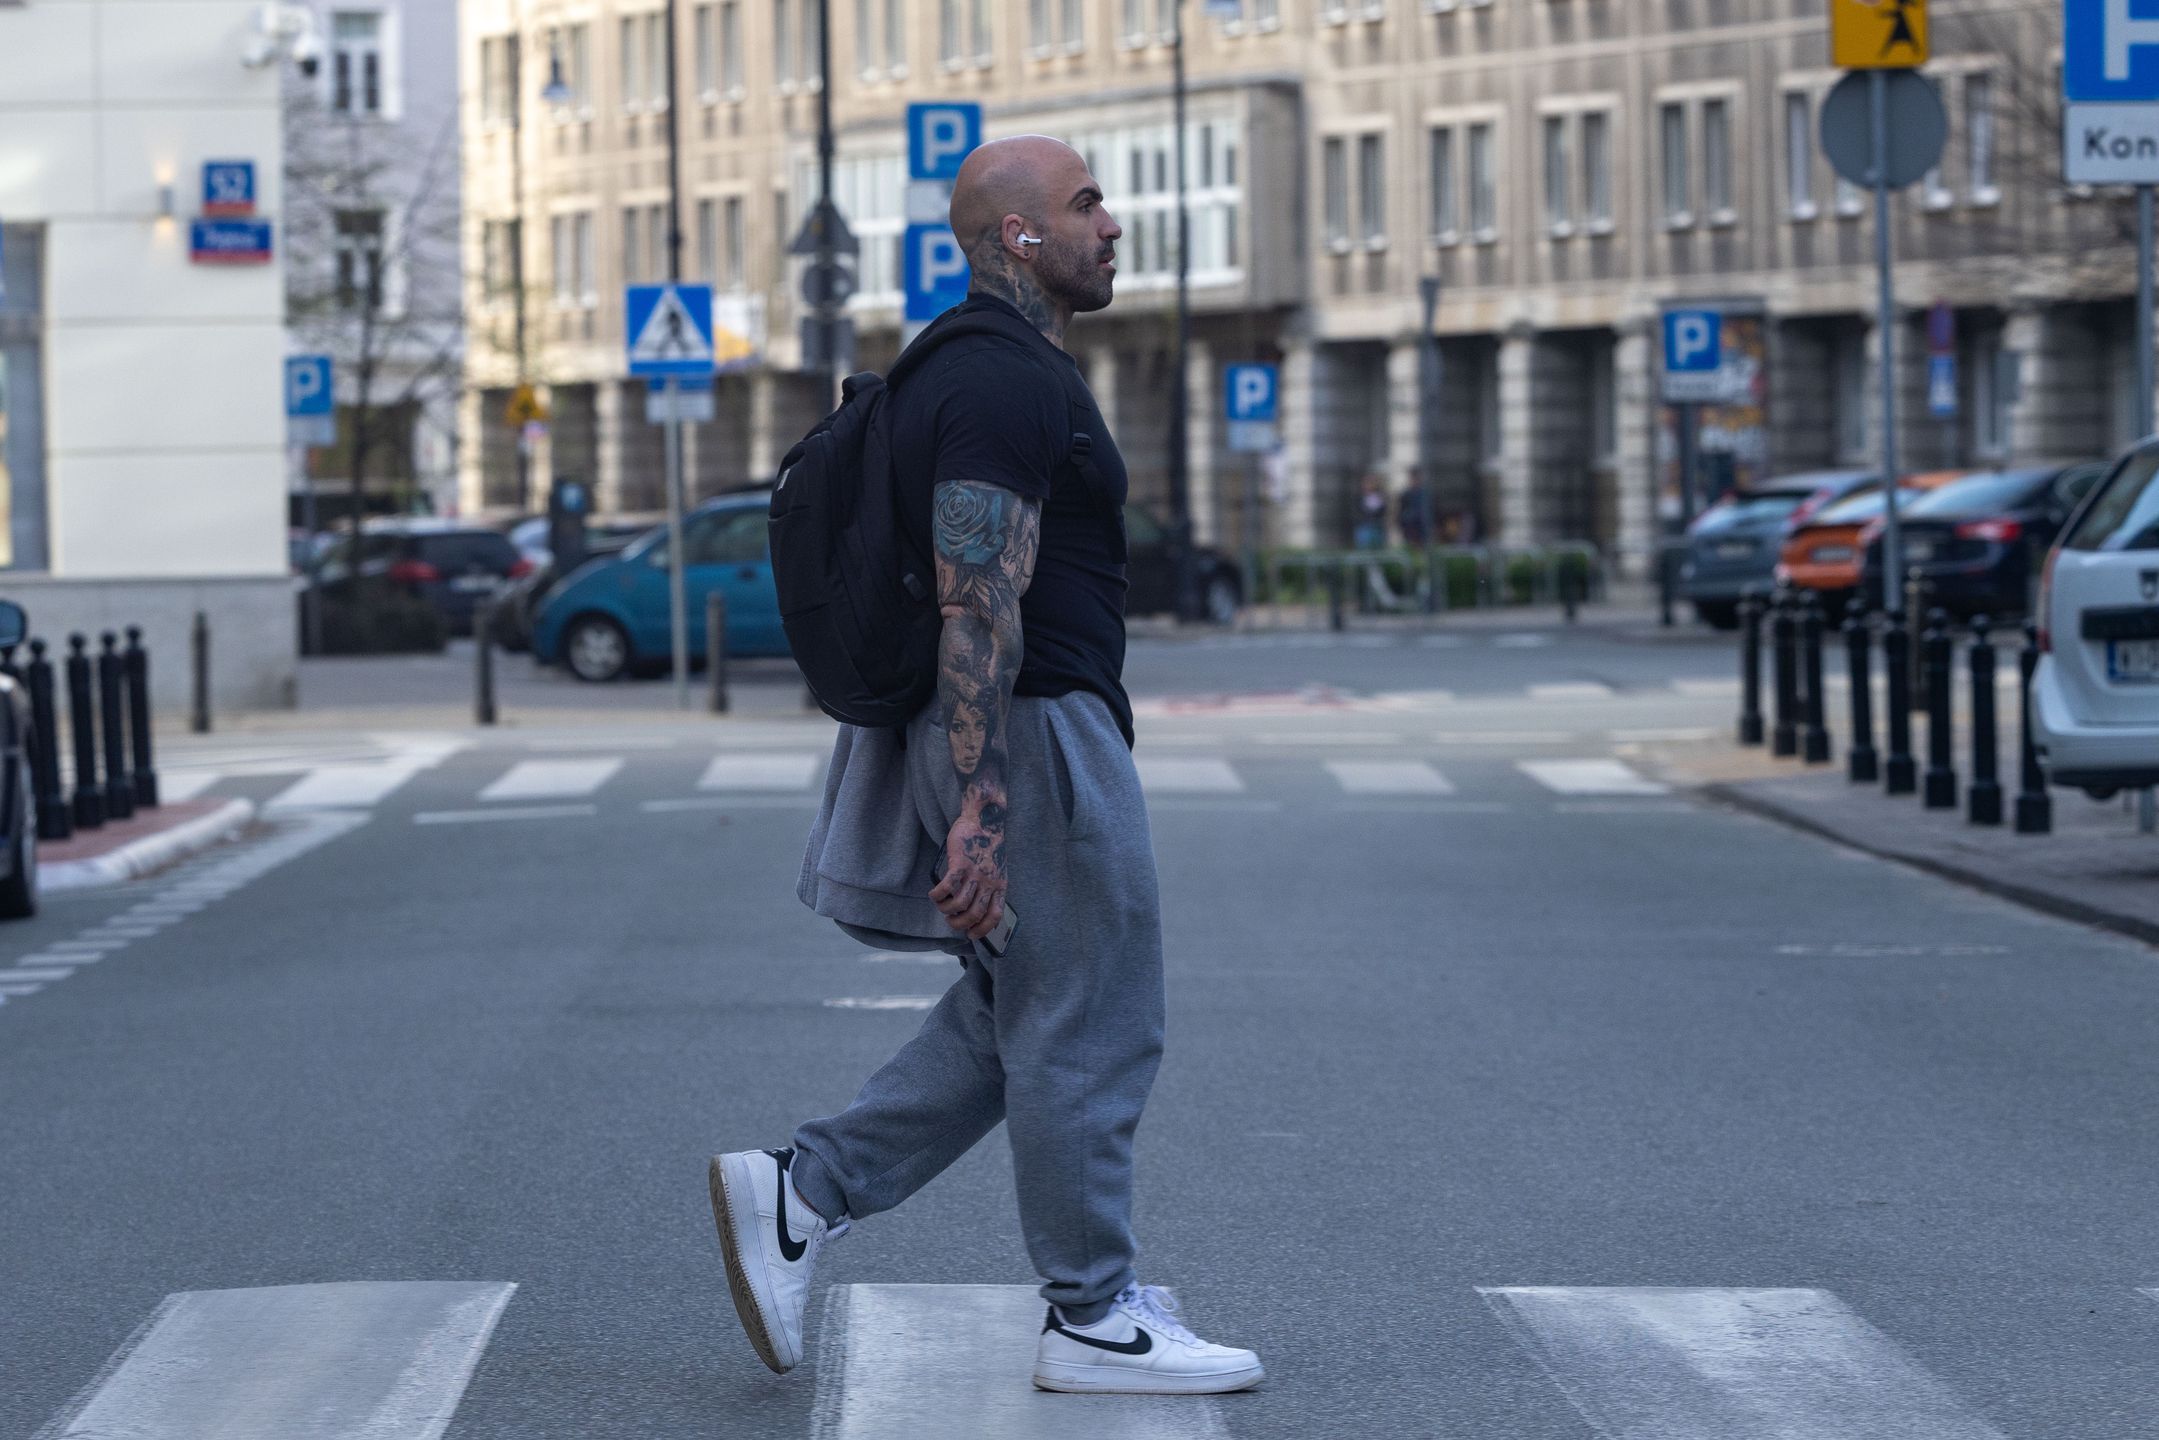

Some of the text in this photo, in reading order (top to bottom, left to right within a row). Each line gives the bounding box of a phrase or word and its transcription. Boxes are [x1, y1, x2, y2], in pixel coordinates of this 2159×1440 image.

[922, 109, 968, 172] P
[2085, 127, 2158, 160] Kon
[919, 230, 967, 294] P
[1673, 314, 1710, 364] P
[289, 363, 322, 406] P
[1235, 366, 1270, 415] P
